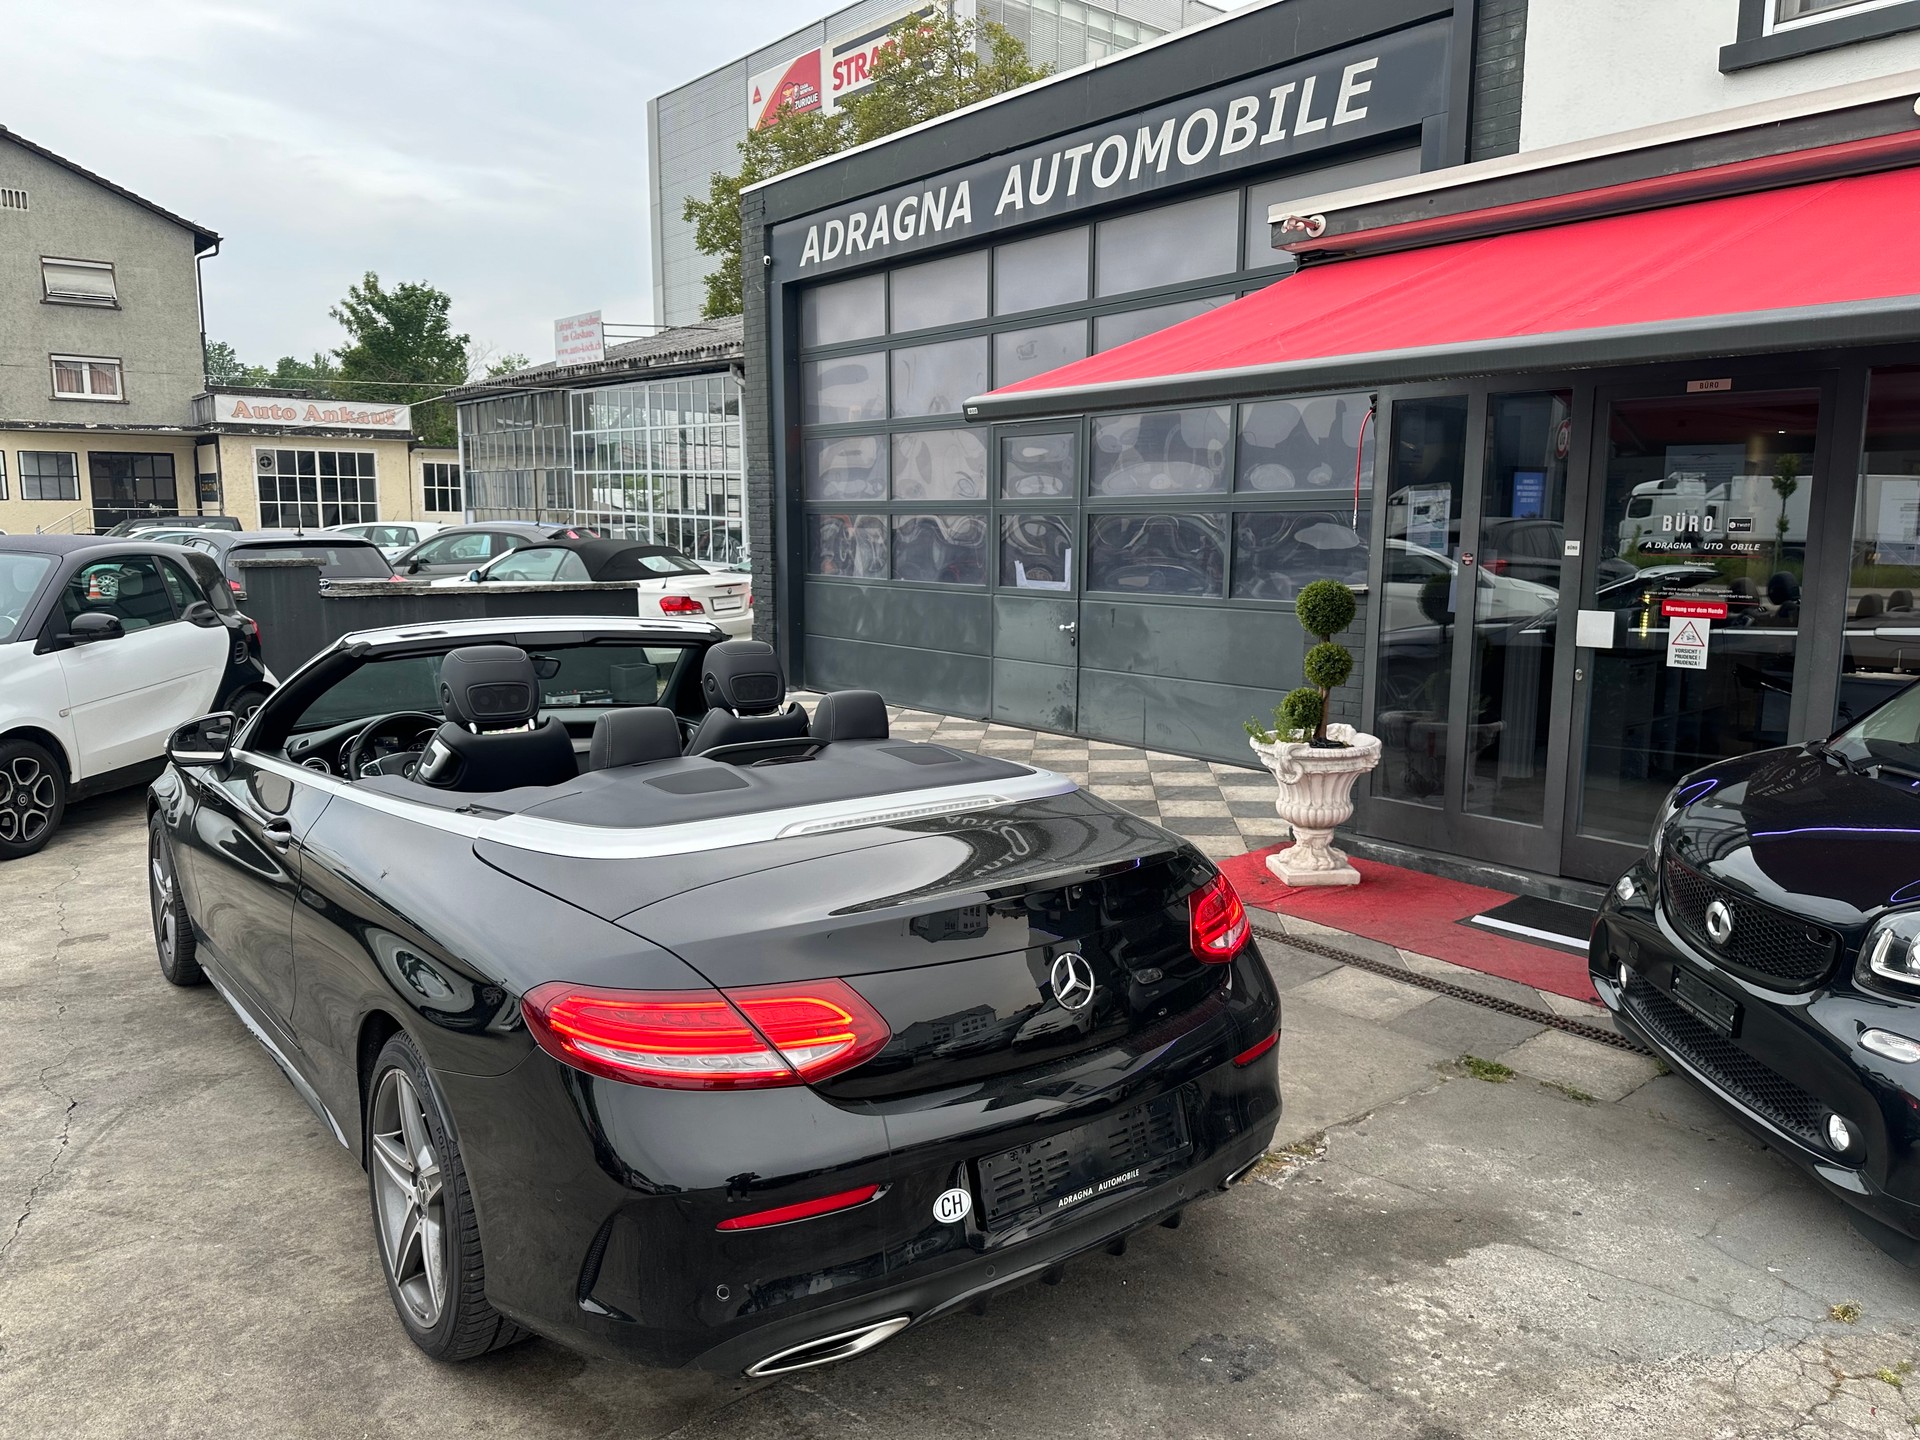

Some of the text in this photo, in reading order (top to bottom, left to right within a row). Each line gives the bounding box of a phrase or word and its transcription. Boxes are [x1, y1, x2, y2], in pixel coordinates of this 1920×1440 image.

[794, 92, 818, 110] ZURIQUE
[798, 56, 1379, 267] ADRAGNA AUTOMOBILE
[1699, 381, 1720, 389] BÜRO
[231, 400, 396, 425] Auto Ankauf
[1662, 512, 1713, 532] BÜRO
[1665, 605, 1687, 614] Warnung
[1058, 1168, 1140, 1208] ADRAGNA AUTOMOBILE
[941, 1193, 964, 1218] CH
